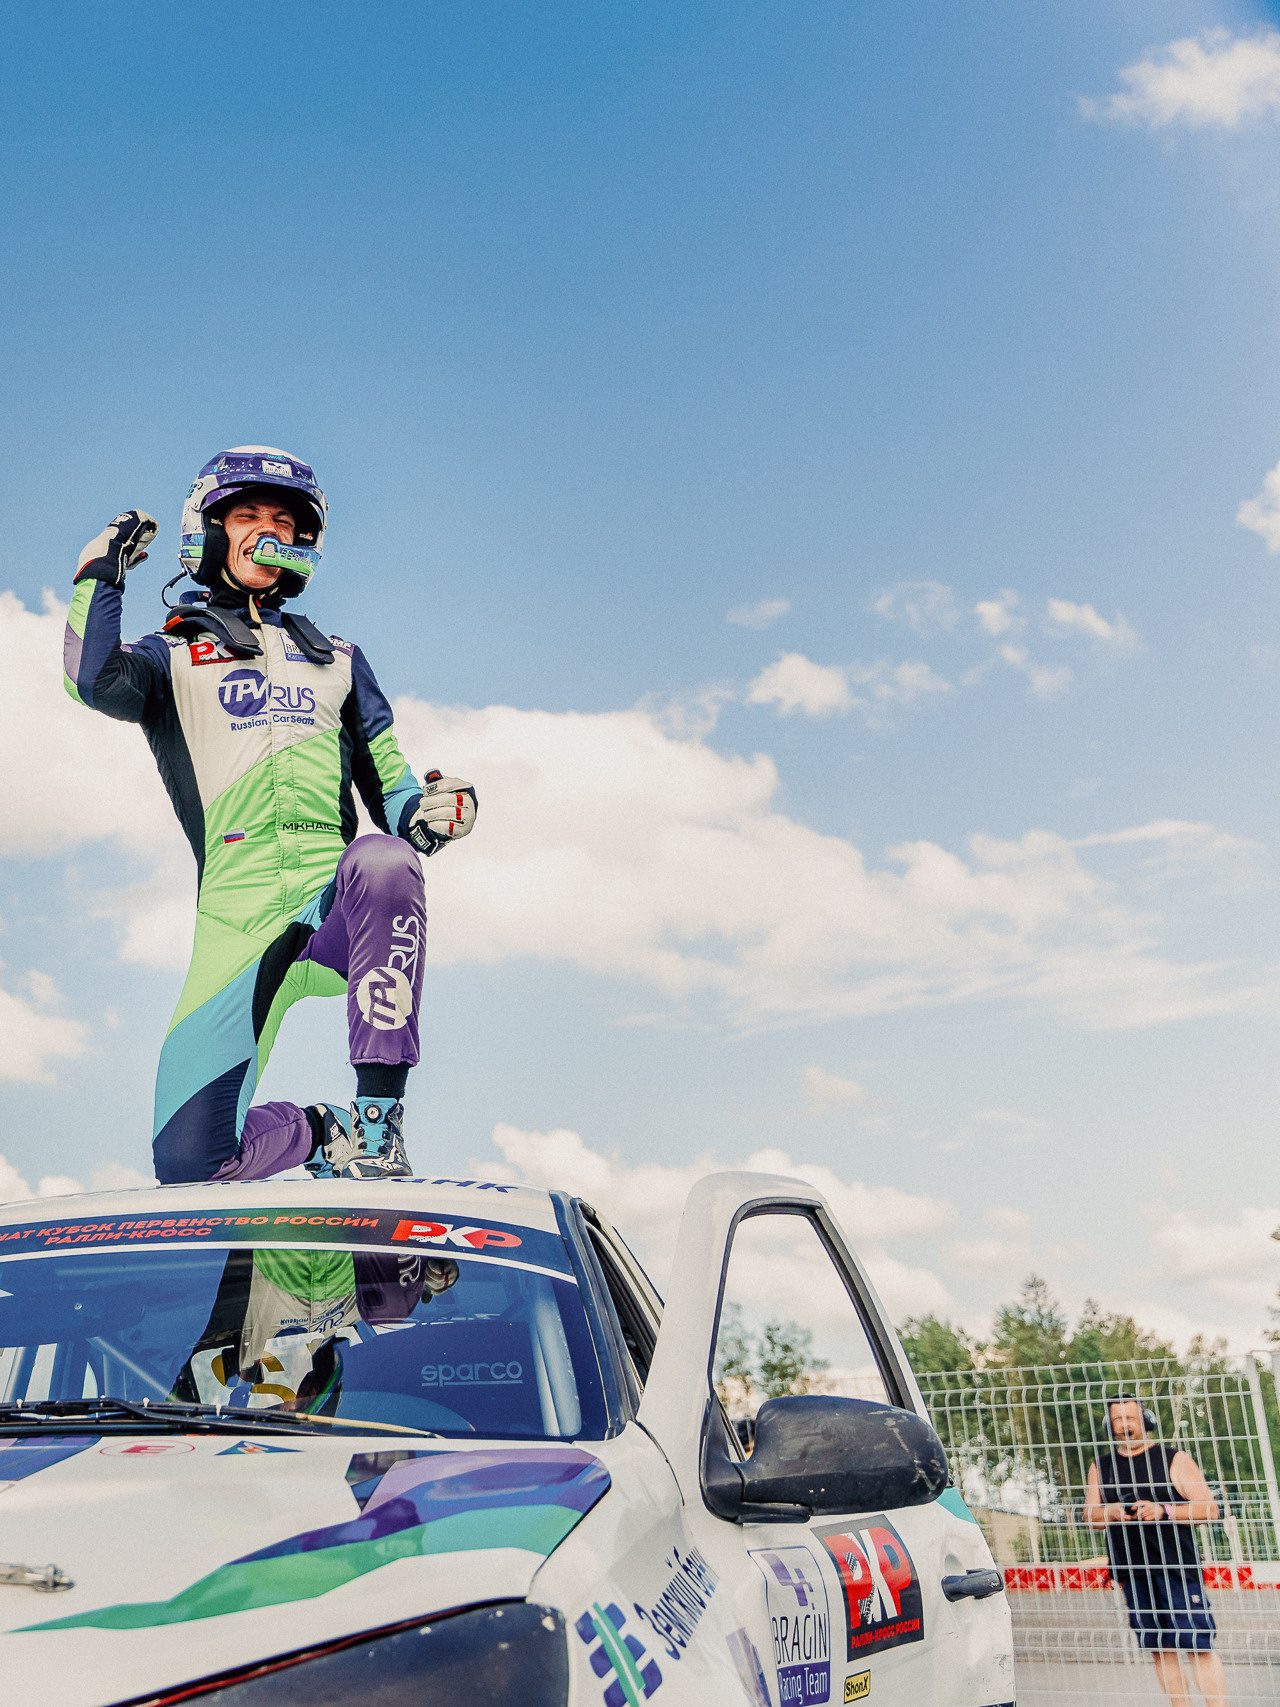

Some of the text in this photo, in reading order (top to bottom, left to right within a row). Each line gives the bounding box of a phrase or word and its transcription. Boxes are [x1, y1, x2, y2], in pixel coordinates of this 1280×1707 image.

[231, 718, 268, 732] Russian
[36, 1221, 116, 1238] КУБОК
[118, 1215, 269, 1231] ПЕРВЕНСТВО
[272, 1215, 380, 1228] РОССИИ
[43, 1227, 213, 1246] РАЛЛИ-КРОСС
[421, 1360, 524, 1388] sparco
[633, 1556, 708, 1661] Земский
[851, 1618, 920, 1649] РАЛЛИ-КРОСС РОССИИ
[778, 1666, 828, 1705] Racing Team
[845, 1675, 869, 1698] ShonX
